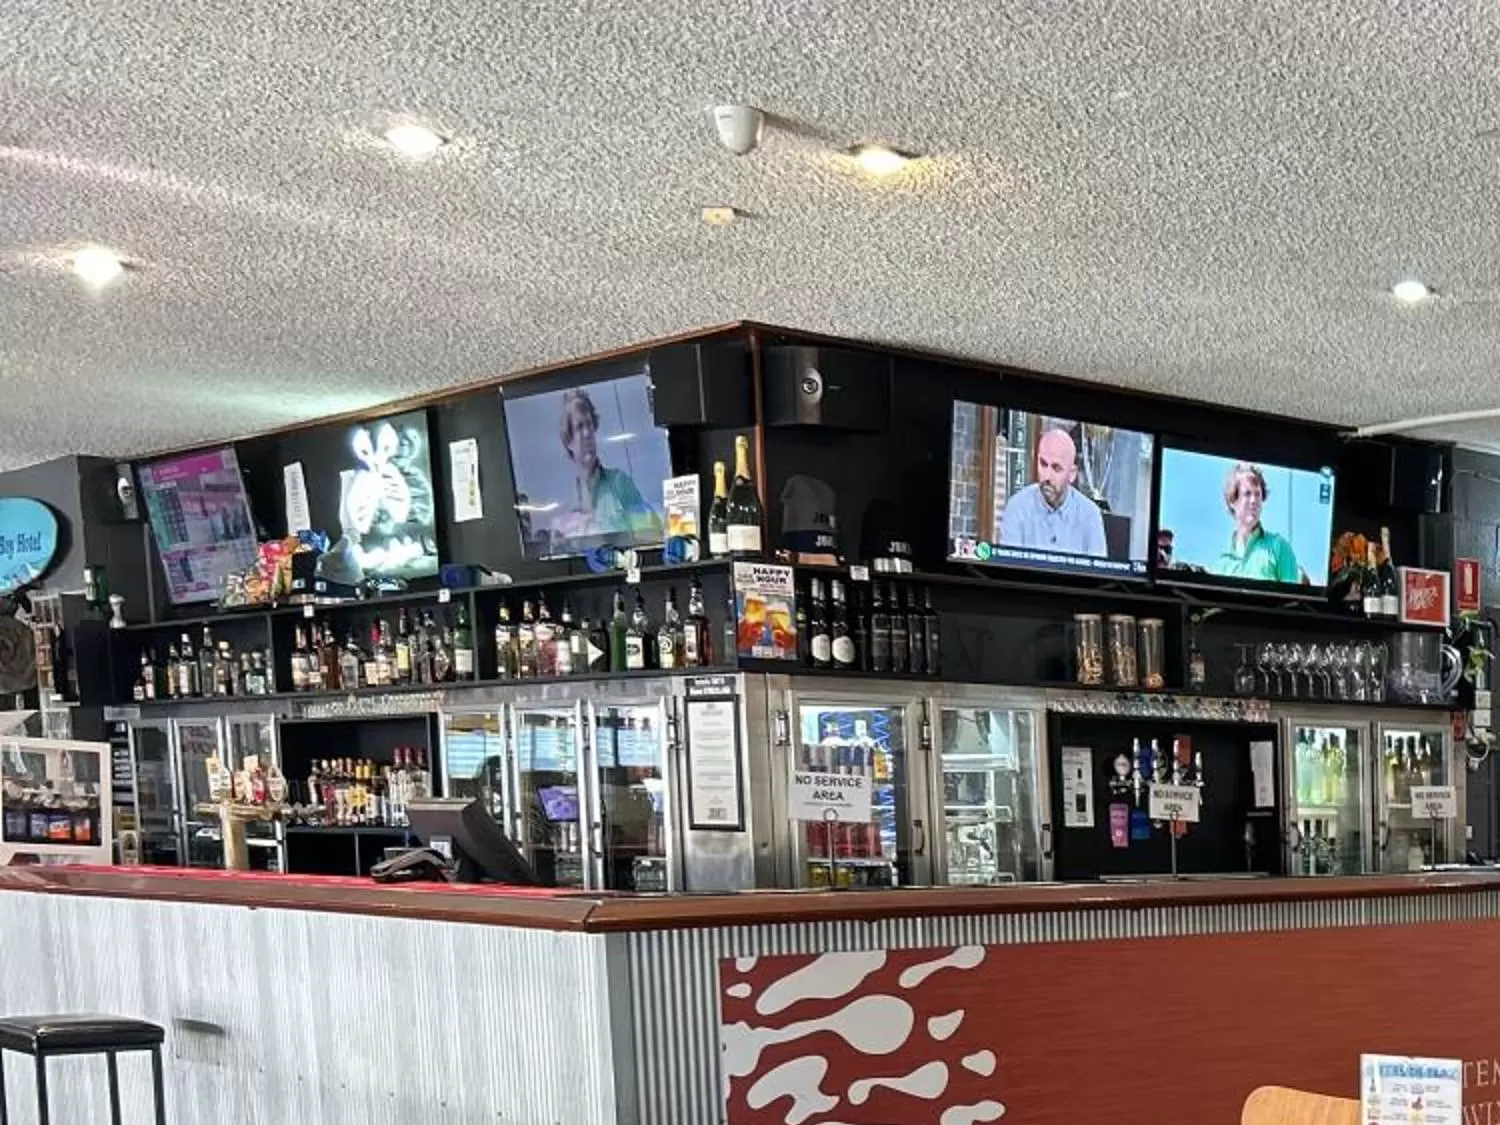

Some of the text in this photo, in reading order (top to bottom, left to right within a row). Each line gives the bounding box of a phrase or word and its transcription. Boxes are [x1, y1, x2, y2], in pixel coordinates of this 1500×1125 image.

[17, 531, 41, 553] Hotel
[753, 567, 790, 577] HAPPY
[756, 575, 787, 584] HOUR
[796, 775, 863, 788] NO SERVICE
[812, 790, 844, 801] AREA
